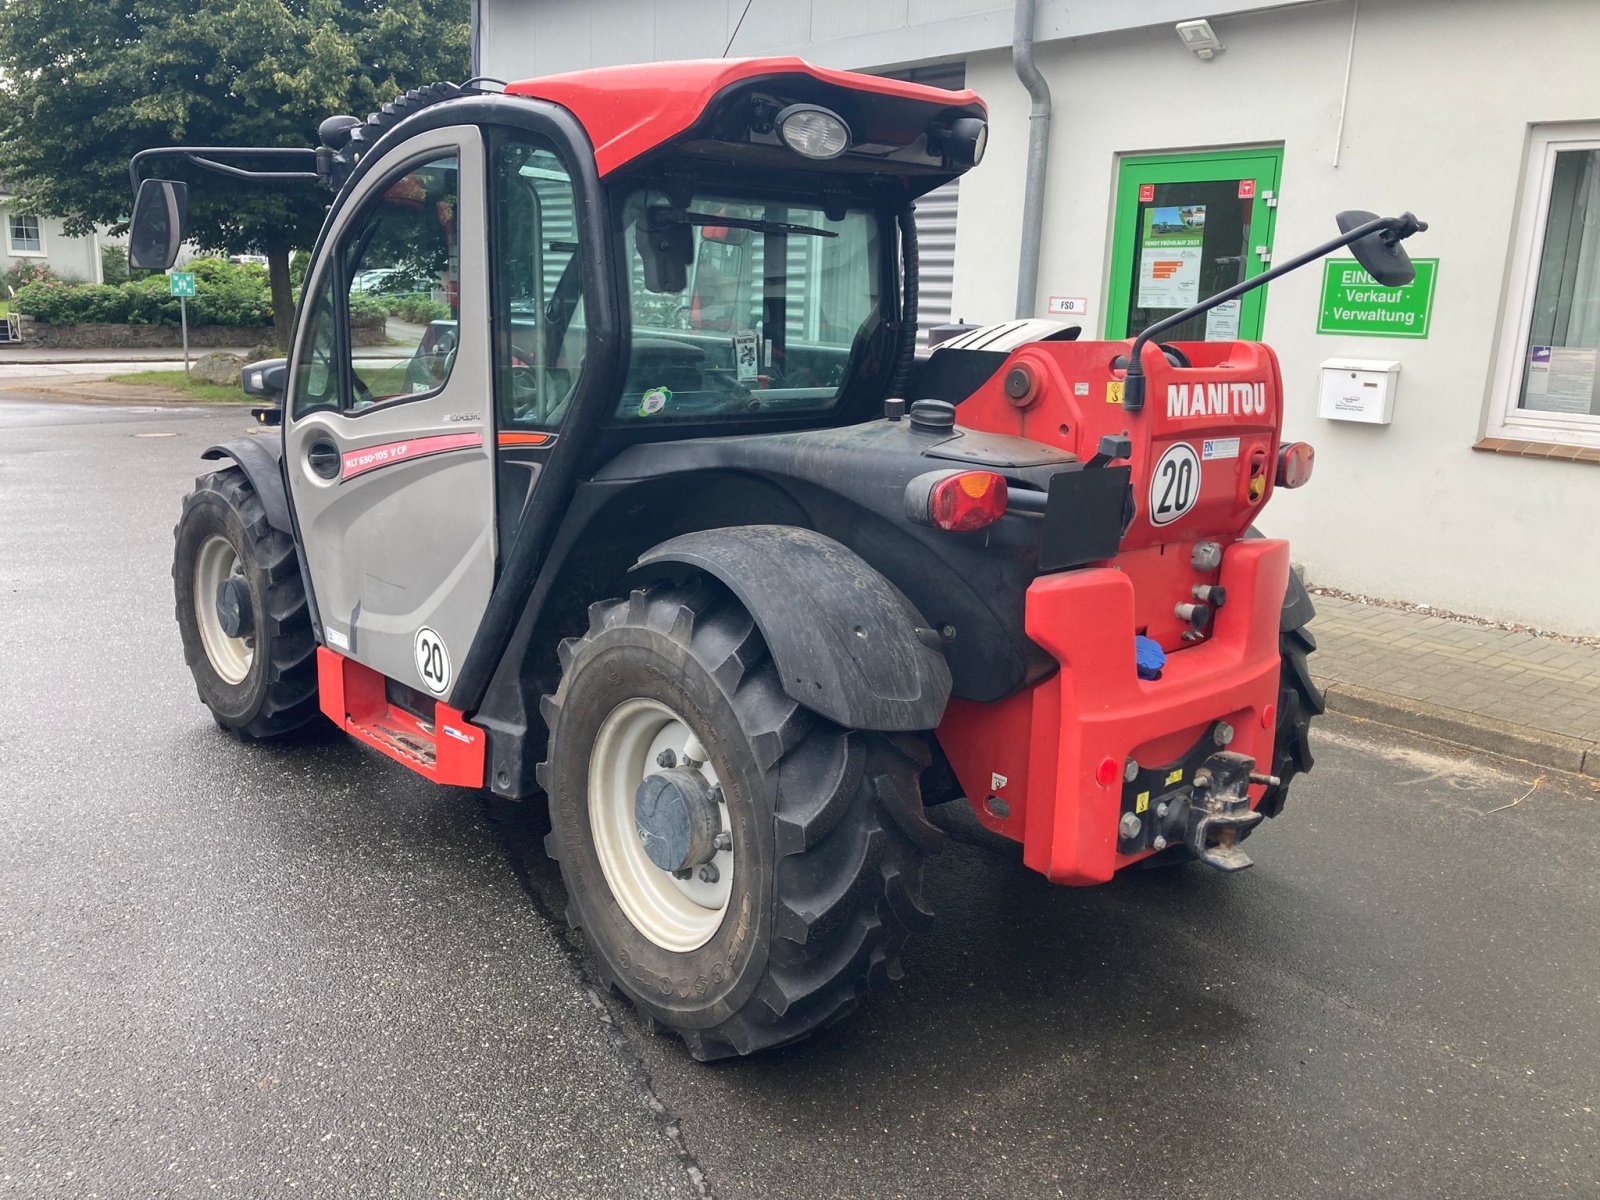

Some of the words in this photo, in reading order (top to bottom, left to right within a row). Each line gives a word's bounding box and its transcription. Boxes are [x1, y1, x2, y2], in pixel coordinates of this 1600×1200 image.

[1060, 301, 1075, 310] FSD
[1346, 289, 1403, 303] Verkauf
[1333, 307, 1415, 326] Verwaltung
[1166, 382, 1266, 418] MANITOU
[1156, 456, 1193, 515] 20
[421, 638, 444, 684] 20
